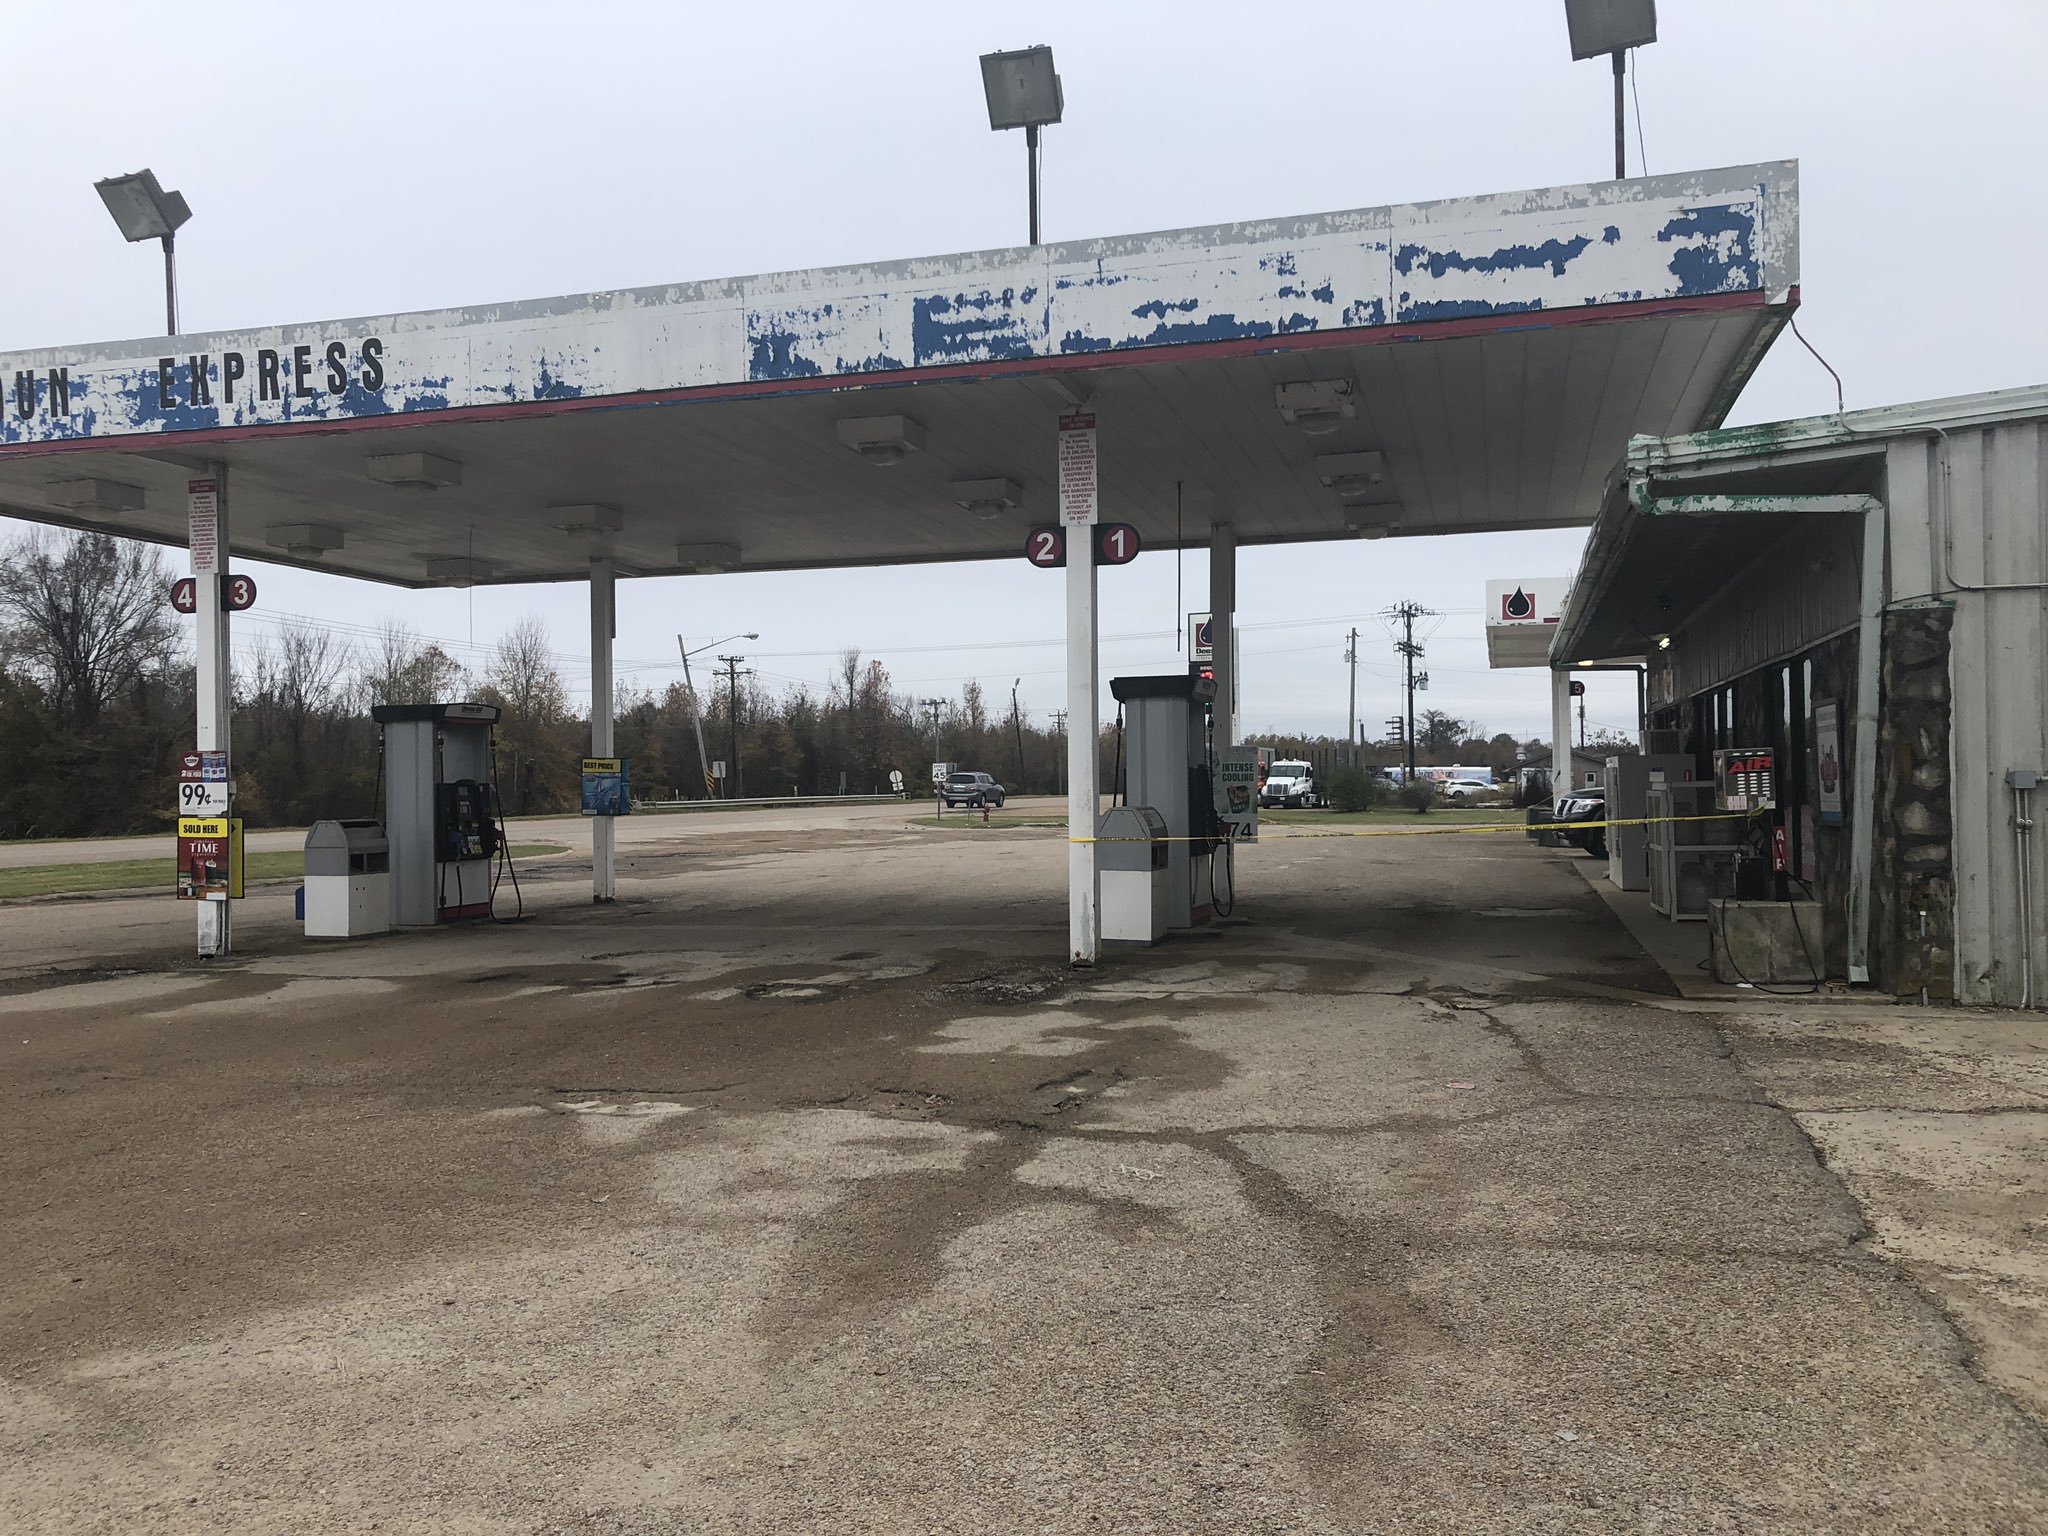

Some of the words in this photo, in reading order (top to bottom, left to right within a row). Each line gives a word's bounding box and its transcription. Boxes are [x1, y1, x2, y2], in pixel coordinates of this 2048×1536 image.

[0, 367, 69, 421] UN
[158, 337, 385, 409] EXPRESS
[1036, 532, 1055, 561] 2
[1111, 529, 1124, 558] 1
[177, 583, 193, 608] 4
[233, 580, 248, 605] 3
[1574, 683, 1581, 693] 5
[1222, 762, 1254, 772] INTENSE
[1727, 756, 1772, 775] AIR
[933, 772, 946, 780] 45
[1222, 773, 1254, 782] COOLING
[183, 824, 201, 834] SOLD
[202, 824, 219, 834] HERE
[189, 843, 219, 853] TIME
[1775, 829, 1785, 869] AIR
